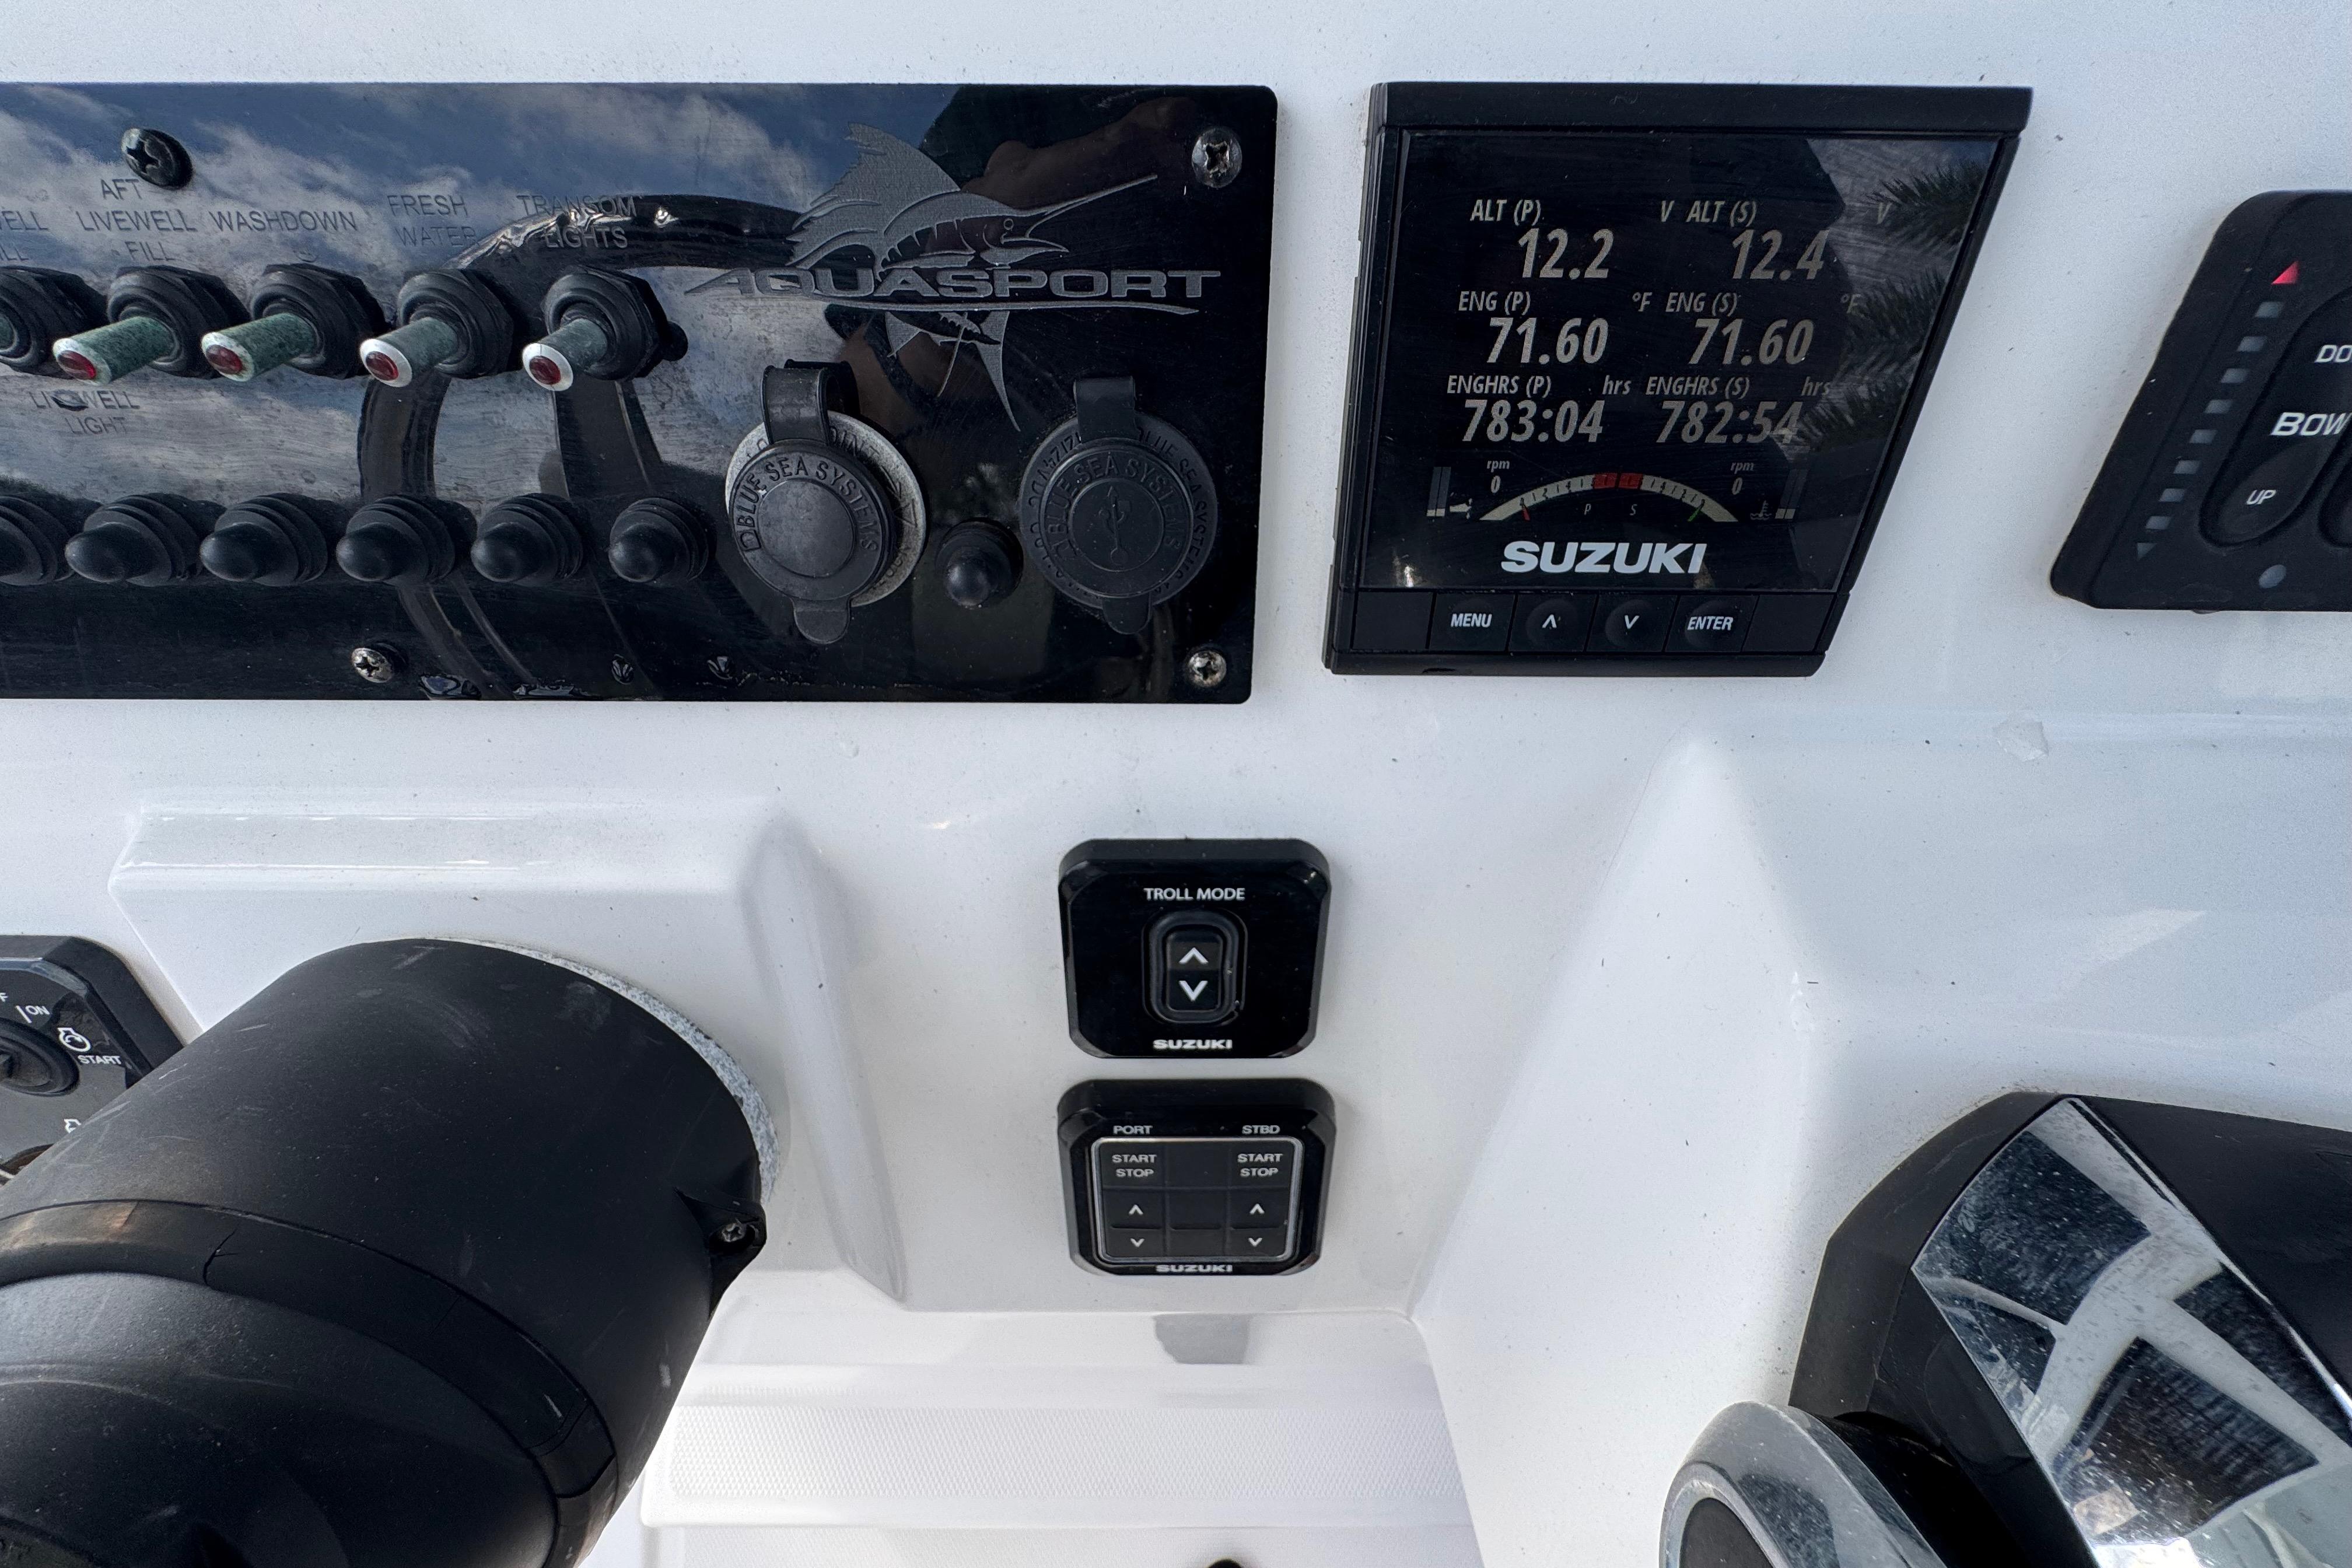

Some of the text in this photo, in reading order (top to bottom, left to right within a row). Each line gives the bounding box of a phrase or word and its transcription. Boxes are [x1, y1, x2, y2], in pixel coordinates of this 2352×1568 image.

[100, 178, 143, 200] AFT
[387, 195, 468, 215] FRESH
[517, 195, 639, 218] TRANSOM
[1470, 200, 1674, 226] ALT (P) V
[1686, 201, 1891, 227] ALT (S) V
[0, 211, 49, 230] ELL
[76, 209, 198, 232] LIVEWELL
[209, 210, 358, 232] WASHDOWN
[397, 226, 480, 248] WATER
[544, 226, 628, 249] LIGHTS
[125, 240, 176, 262] FILL
[1518, 228, 1615, 279] 12.2
[1731, 229, 1829, 280] 12.4
[684, 269, 1221, 298] AQUASPORT
[1458, 290, 1497, 312] ENG
[1504, 290, 1531, 316] (P)
[1666, 292, 1706, 313] ENG
[1710, 292, 1738, 317] (S)
[1486, 317, 1609, 364] 71.60
[1688, 318, 1815, 365] 71.60
[1447, 376, 1632, 399] ENGHRS (P) hrs
[1646, 376, 1831, 400] ENGHRS (S) hrs
[65, 416, 128, 435] LIGHT
[1462, 400, 1605, 442] 783:04
[1656, 400, 1803, 443] 782:54
[2272, 412, 2352, 436] BOW
[1486, 460, 1510, 473] rpm
[1731, 461, 1754, 474] rpm
[1046, 478, 1079, 533] BLUE
[1073, 454, 1120, 484] SEA
[1490, 476, 1501, 494] 0
[1732, 477, 1742, 495] 0
[737, 456, 878, 551] BLUE SEA SYSTEMS
[2246, 490, 2275, 505] UP
[1584, 503, 1591, 516] P
[1630, 503, 1637, 516] S
[1501, 541, 1707, 575] SUZUKI
[1450, 614, 1492, 628] MENU
[1687, 616, 1734, 631] ENTER
[1144, 888, 1245, 900] TROLL MODE
[26, 1005, 50, 1015] ON
[1153, 1040, 1233, 1049] SUZUKI
[78, 1054, 121, 1065] START
[1113, 1125, 1153, 1134] PORT
[1242, 1125, 1280, 1134] STBD
[1112, 1154, 1157, 1163] START
[1237, 1153, 1283, 1163] START
[1116, 1168, 1154, 1177] STOP
[1240, 1167, 1279, 1177] STOP
[1156, 1265, 1233, 1273] SUZUKI
